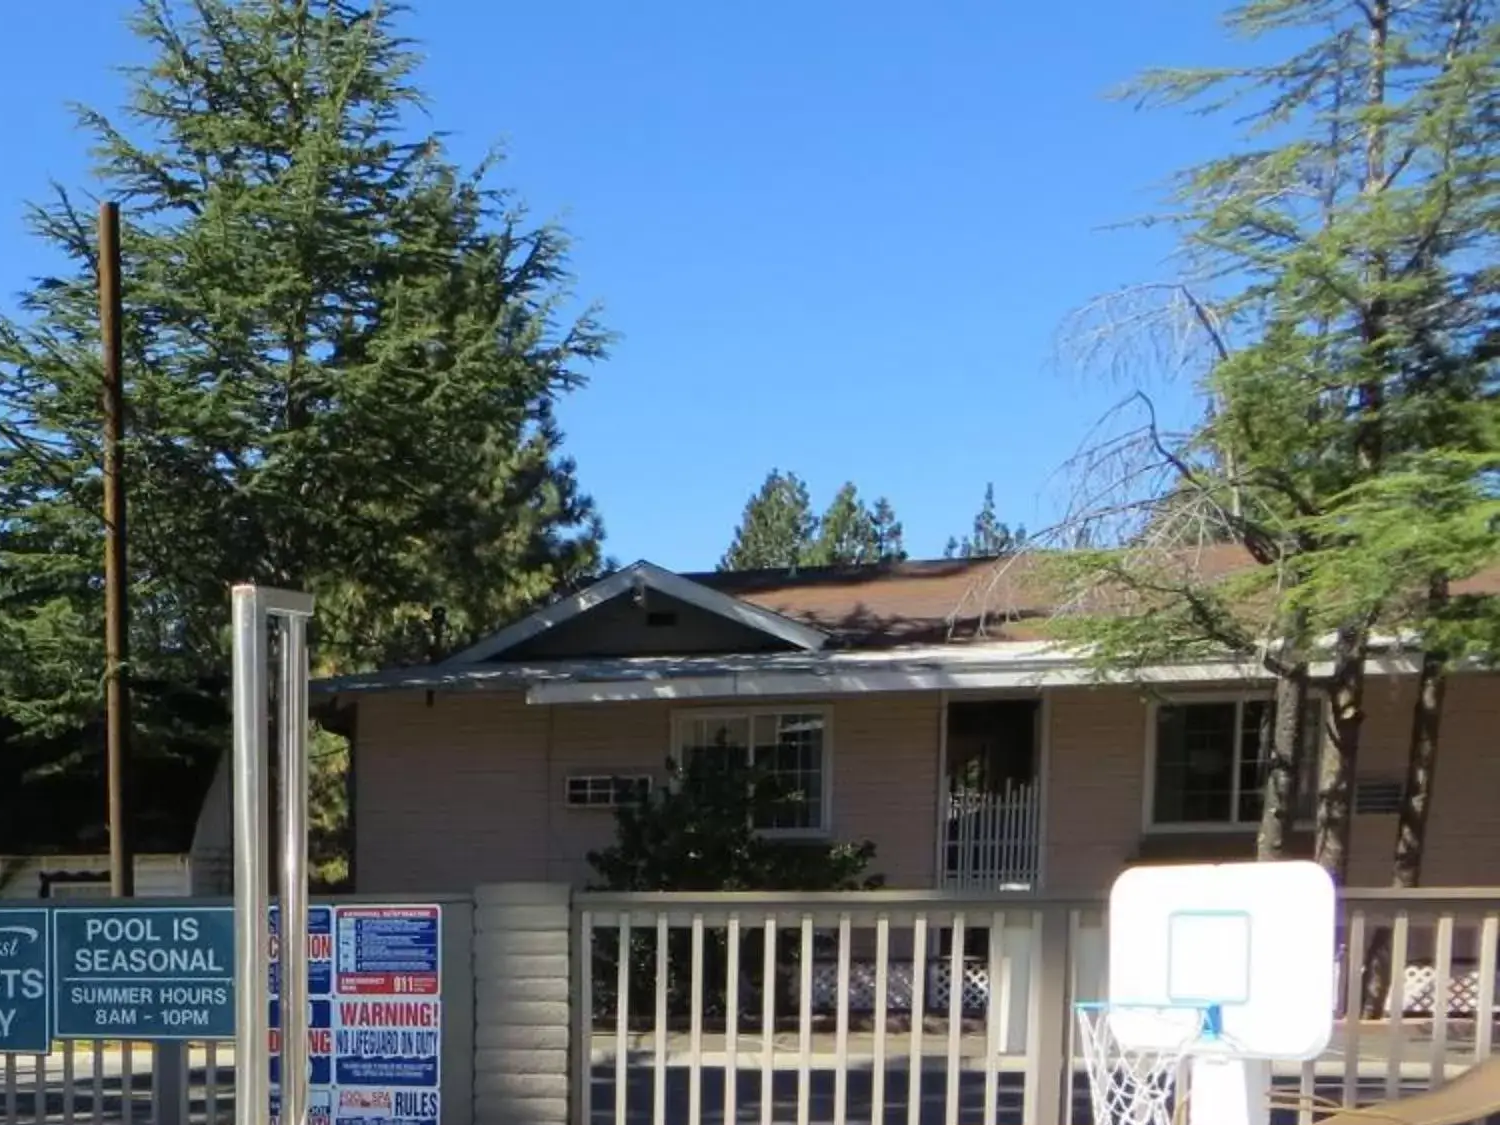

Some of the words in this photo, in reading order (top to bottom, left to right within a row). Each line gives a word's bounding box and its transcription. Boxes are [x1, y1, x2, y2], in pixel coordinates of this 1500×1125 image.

[86, 917, 162, 943] POOL
[173, 916, 200, 942] IS
[74, 948, 225, 973] SEASONAL
[71, 987, 153, 1004] SUMMER
[160, 987, 227, 1005] HOURS
[393, 975, 413, 992] 911
[95, 1009, 137, 1025] 8AM
[161, 1009, 210, 1025] 10PM
[339, 1002, 438, 1027] WARNING!
[336, 1030, 348, 1054] NO
[351, 1030, 398, 1055] LIFEGUARD
[401, 1031, 413, 1055] ON
[416, 1031, 438, 1055] DUTY
[394, 1091, 438, 1117] RULES
